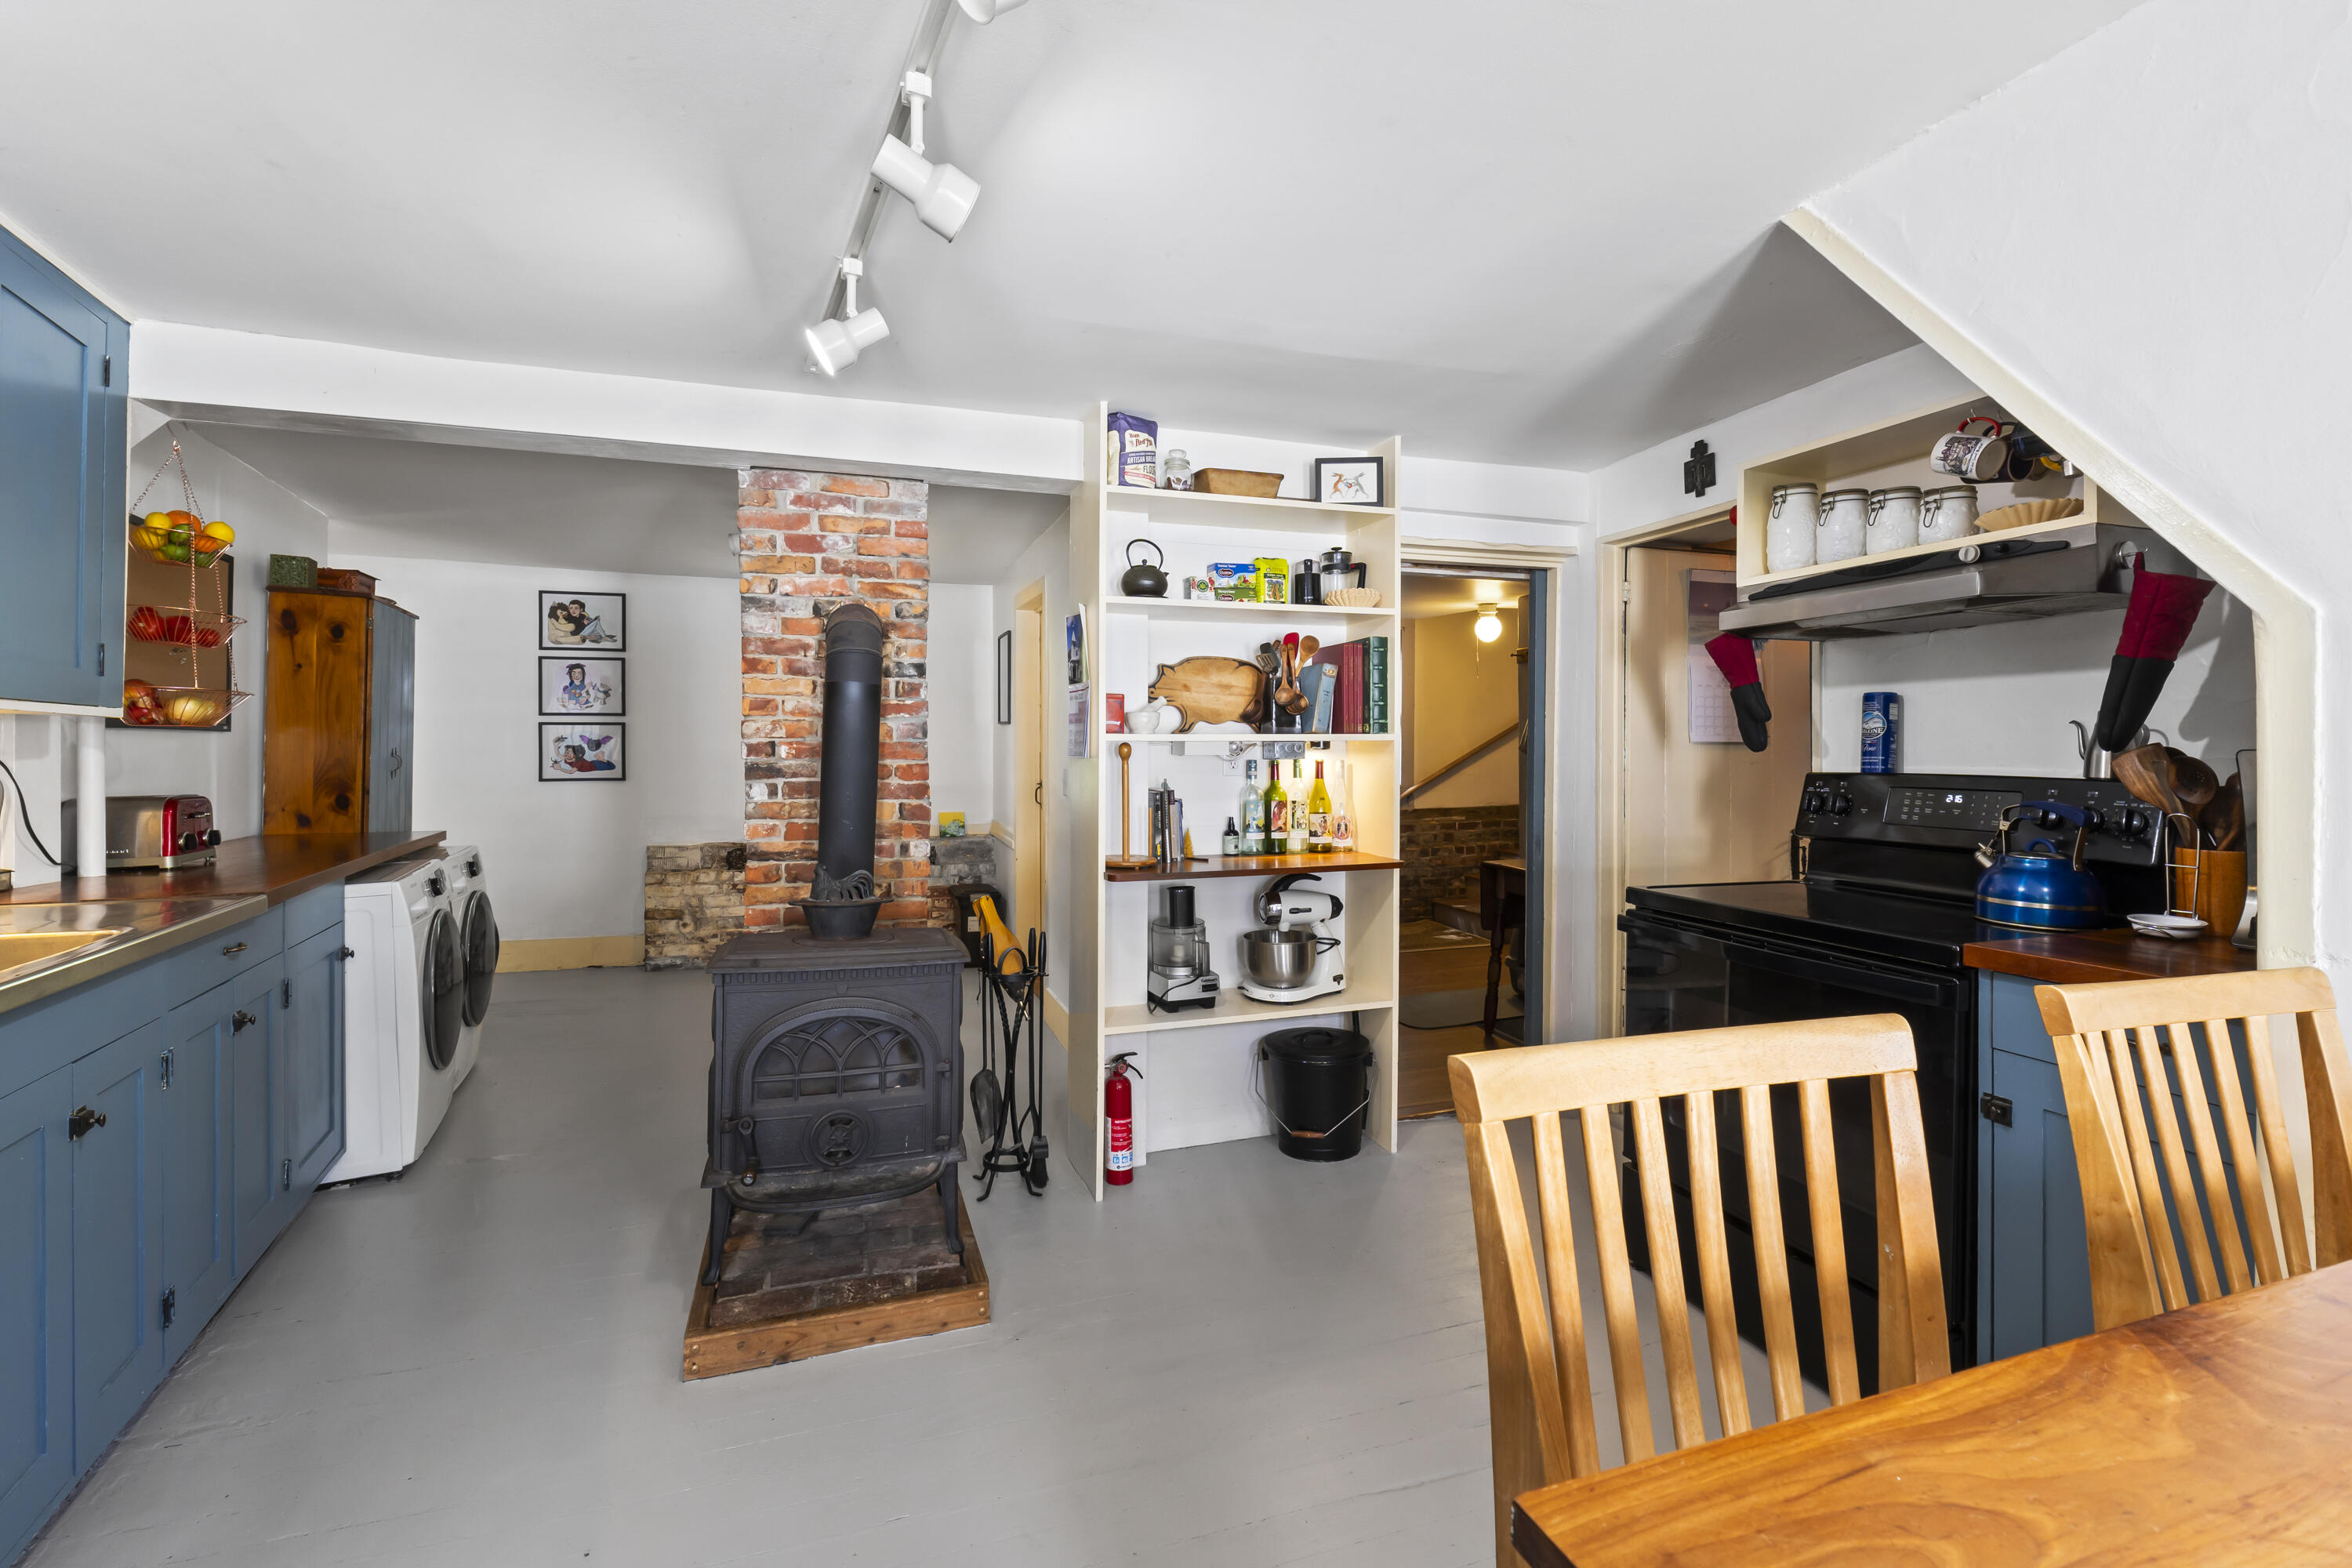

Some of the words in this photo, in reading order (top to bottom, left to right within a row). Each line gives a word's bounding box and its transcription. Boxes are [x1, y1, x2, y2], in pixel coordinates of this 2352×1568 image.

[1135, 438, 1145, 447] Red
[1127, 456, 1145, 464] ARTISAN
[1145, 456, 1156, 464] BREA
[1946, 794, 1963, 804] 2:16
